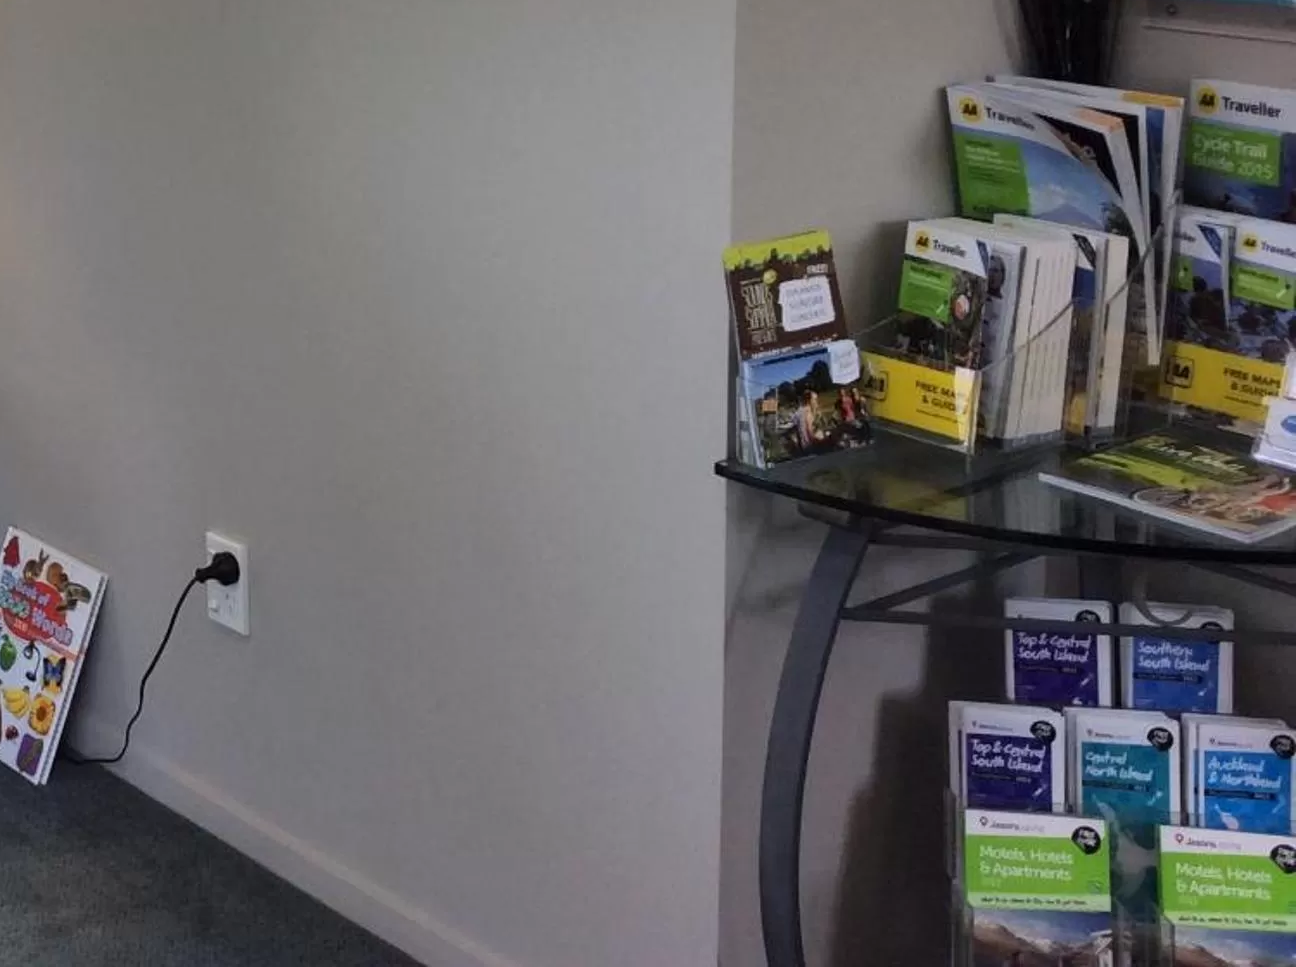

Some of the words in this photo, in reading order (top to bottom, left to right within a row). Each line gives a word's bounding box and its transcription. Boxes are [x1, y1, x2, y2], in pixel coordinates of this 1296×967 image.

[1222, 96, 1281, 118] Traveller
[971, 739, 992, 756] Top
[1030, 848, 1074, 865] Hotels
[993, 862, 1073, 882] Apartments
[1226, 864, 1273, 883] Hotels
[1190, 880, 1272, 902] Apartments
